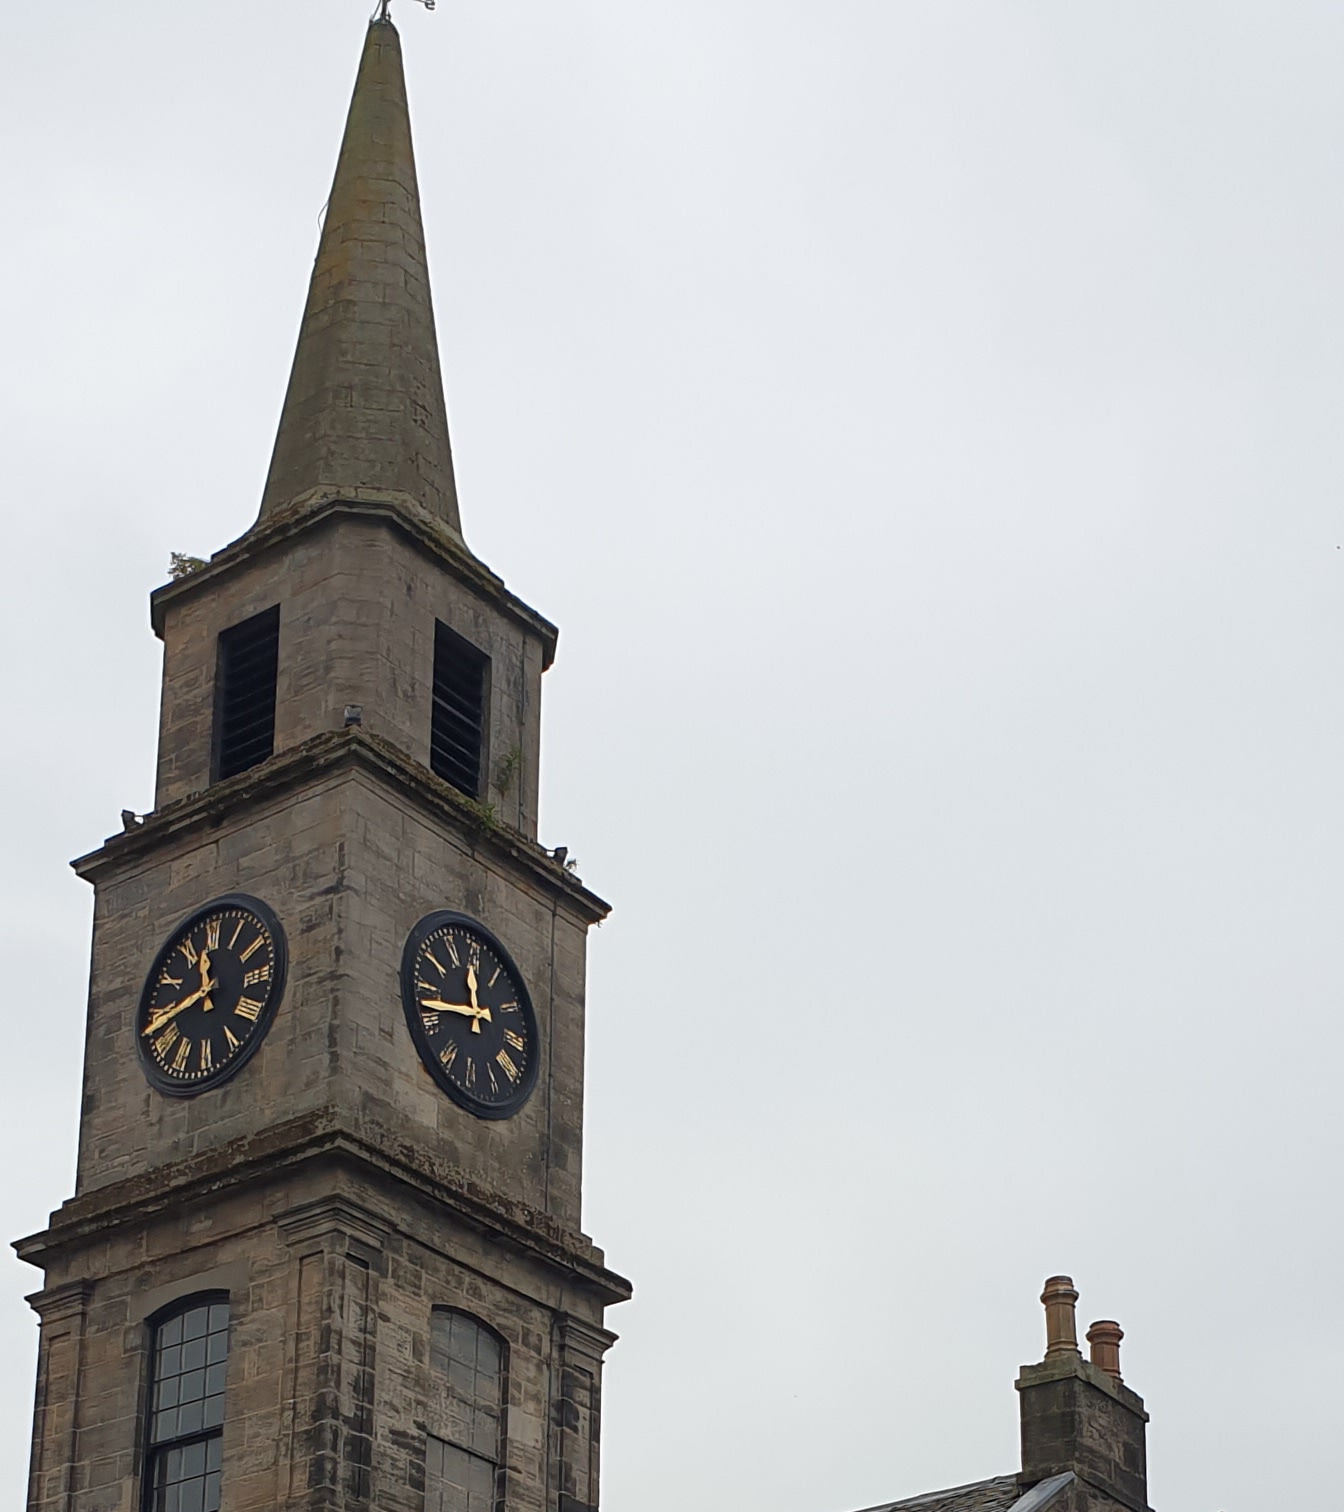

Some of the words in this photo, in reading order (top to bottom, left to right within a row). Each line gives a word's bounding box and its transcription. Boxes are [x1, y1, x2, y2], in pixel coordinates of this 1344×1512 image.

[227, 919, 245, 950] I
[240, 934, 265, 963] II
[160, 973, 184, 990] X
[224, 1025, 240, 1052] V
